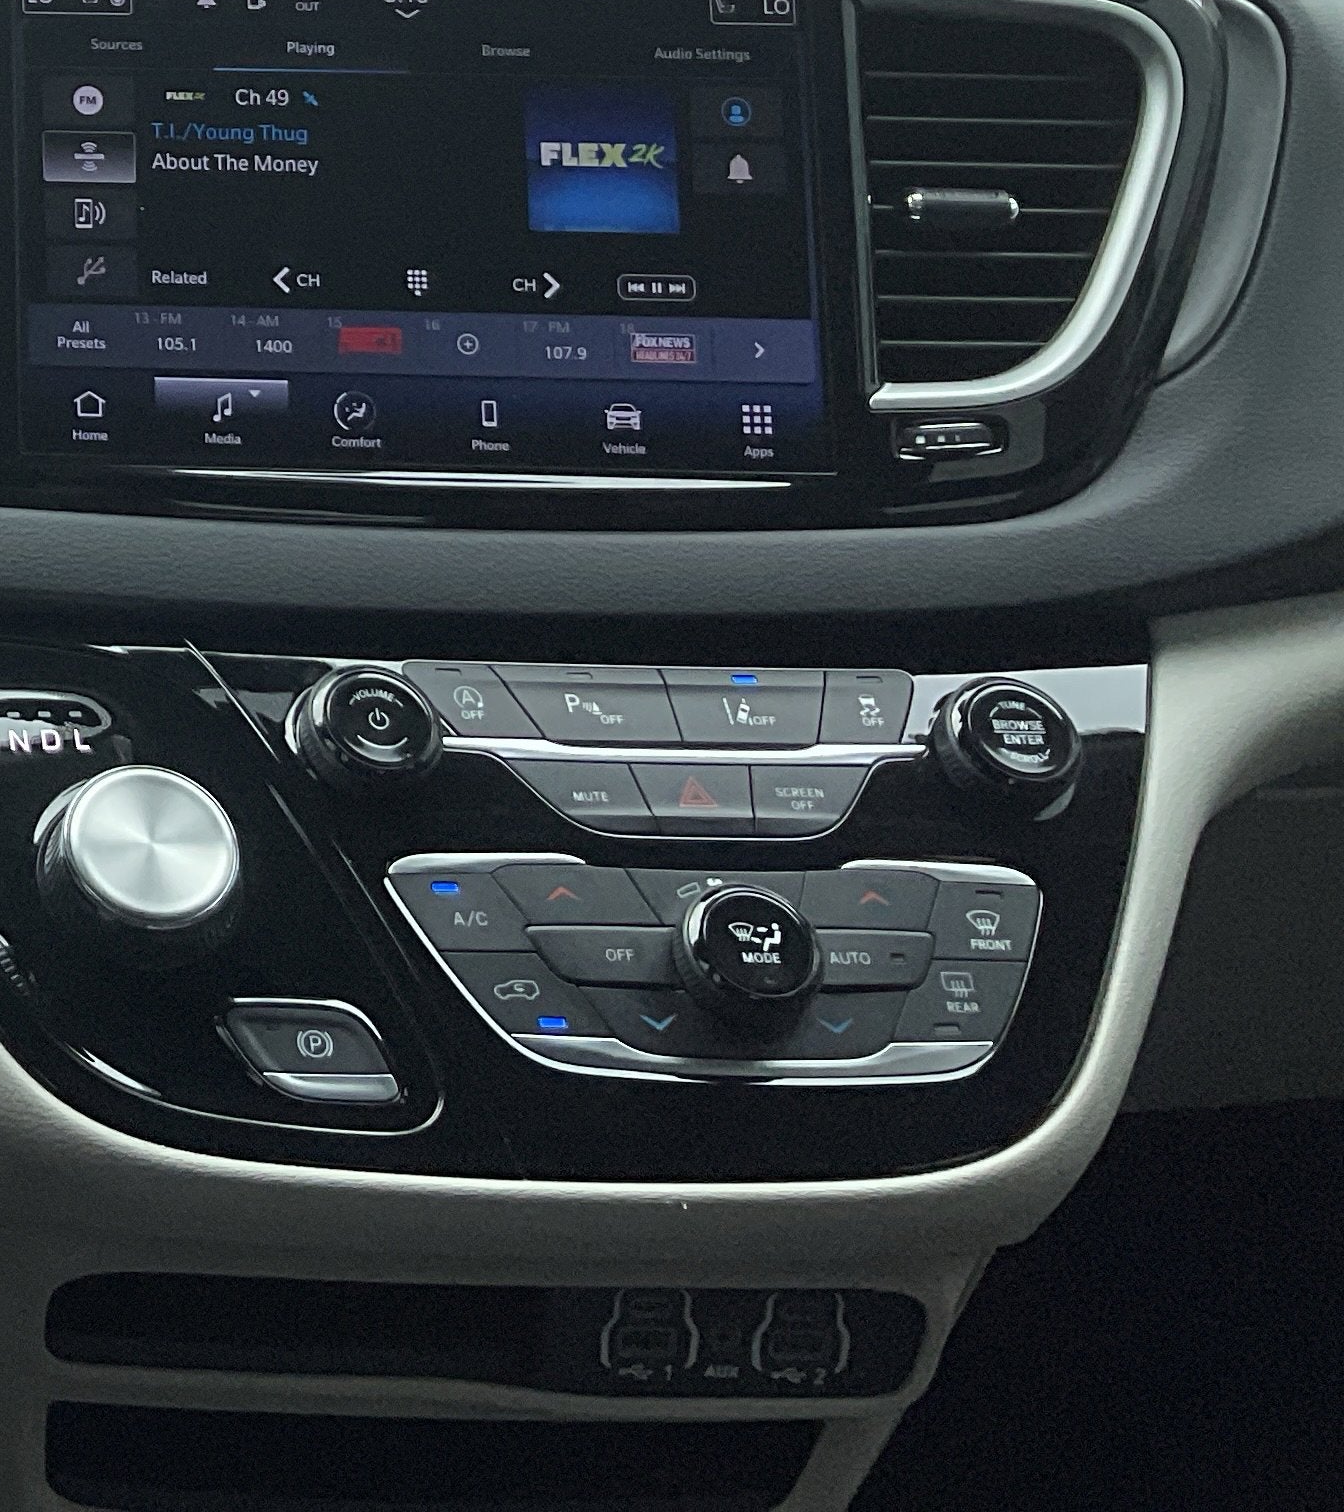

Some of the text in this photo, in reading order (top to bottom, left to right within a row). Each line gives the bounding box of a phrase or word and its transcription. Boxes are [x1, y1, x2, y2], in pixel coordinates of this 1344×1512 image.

[295, 1, 320, 12] OUT
[90, 38, 751, 64] Sources Playing Browse Audio Settings
[78, 95, 97, 106] FM
[235, 89, 261, 106] Ch
[265, 90, 289, 106] 49
[259, 124, 309, 145] Thug
[539, 142, 629, 168] FLEX
[151, 153, 319, 176] About The Money
[151, 270, 537, 292] Related CH CH
[256, 314, 280, 327] AM
[57, 336, 107, 350] Presets
[72, 320, 90, 335] All
[156, 338, 197, 352] 105.1
[255, 339, 293, 354] 1400
[544, 345, 587, 361] 107.9
[72, 429, 775, 460] Home Media Comfort Phone Vehicle Apps
[353, 688, 395, 703] VOLUME
[461, 709, 485, 720] OFF
[600, 714, 626, 725] OFF
[752, 714, 777, 727] OFF
[862, 716, 886, 728] OFF
[992, 719, 1045, 731] BROWSE
[1003, 733, 1045, 745] ENTER
[572, 790, 609, 803] MUTE
[775, 787, 825, 800] SCREEN
[791, 800, 815, 812] OFF
[454, 911, 489, 927] A/C
[970, 938, 1013, 952] FRONT
[605, 948, 635, 962] OFF
[742, 952, 782, 965] MODE
[830, 951, 872, 966] AUTO
[946, 1001, 980, 1014] REAR
